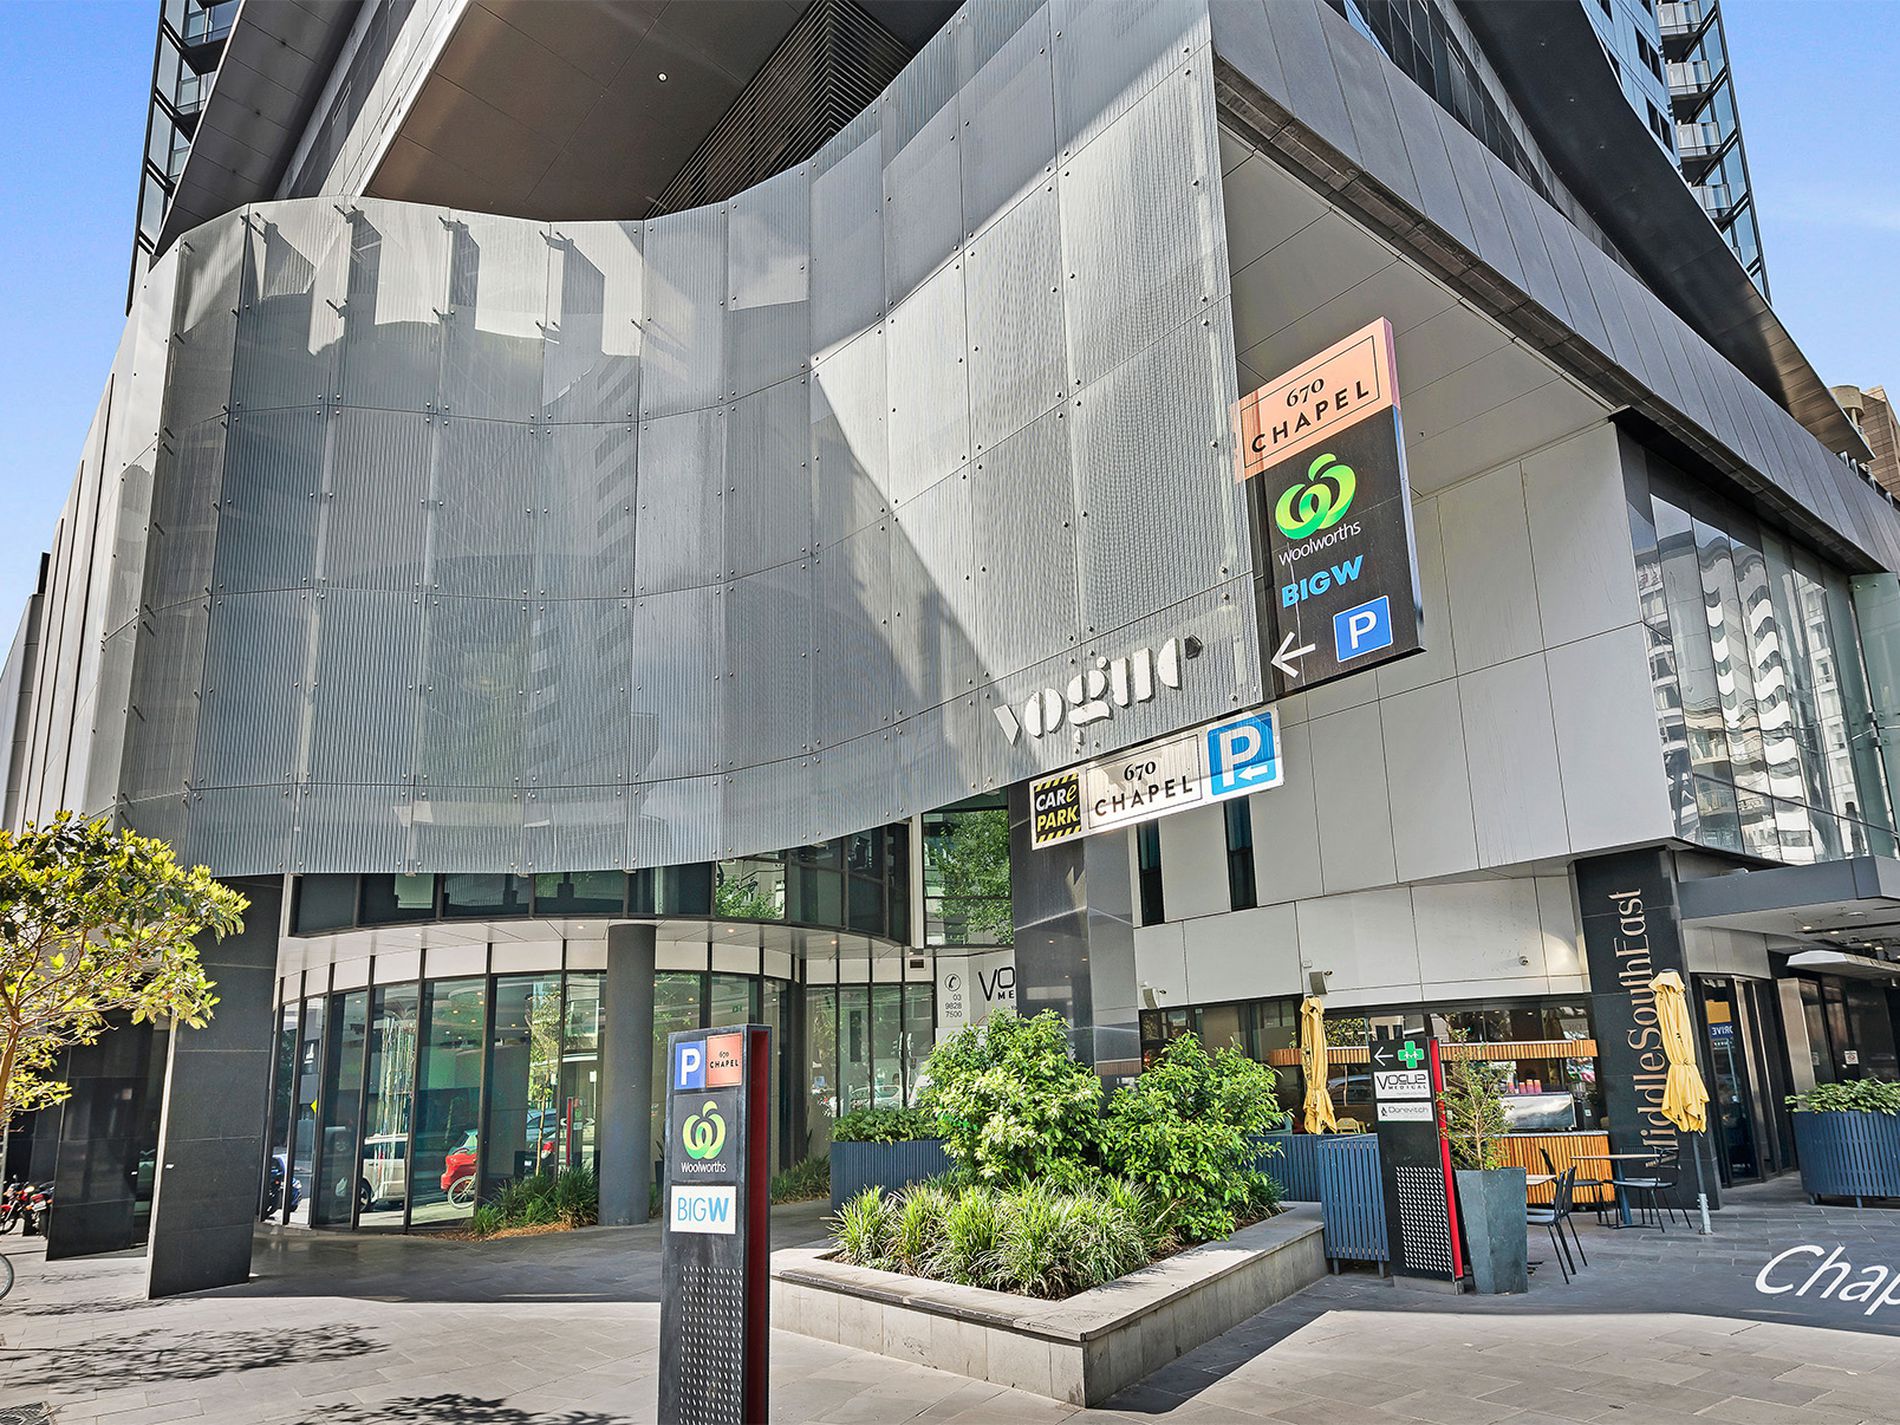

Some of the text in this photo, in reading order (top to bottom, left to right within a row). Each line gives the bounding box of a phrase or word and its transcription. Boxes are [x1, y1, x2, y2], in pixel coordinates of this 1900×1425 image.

[1286, 378, 1325, 407] 670
[1251, 381, 1370, 453] CHAPEL
[1349, 611, 1378, 650] P
[1123, 760, 1157, 782] 670
[1219, 725, 1262, 788] P
[1094, 774, 1193, 817] CHAPEL
[1037, 804, 1079, 833] PARK
[952, 993, 962, 1001] 03
[945, 1010, 963, 1018] 7500
[680, 1047, 701, 1086] P
[709, 1058, 739, 1069] CHAPEL
[680, 1161, 727, 1174] Woolworths
